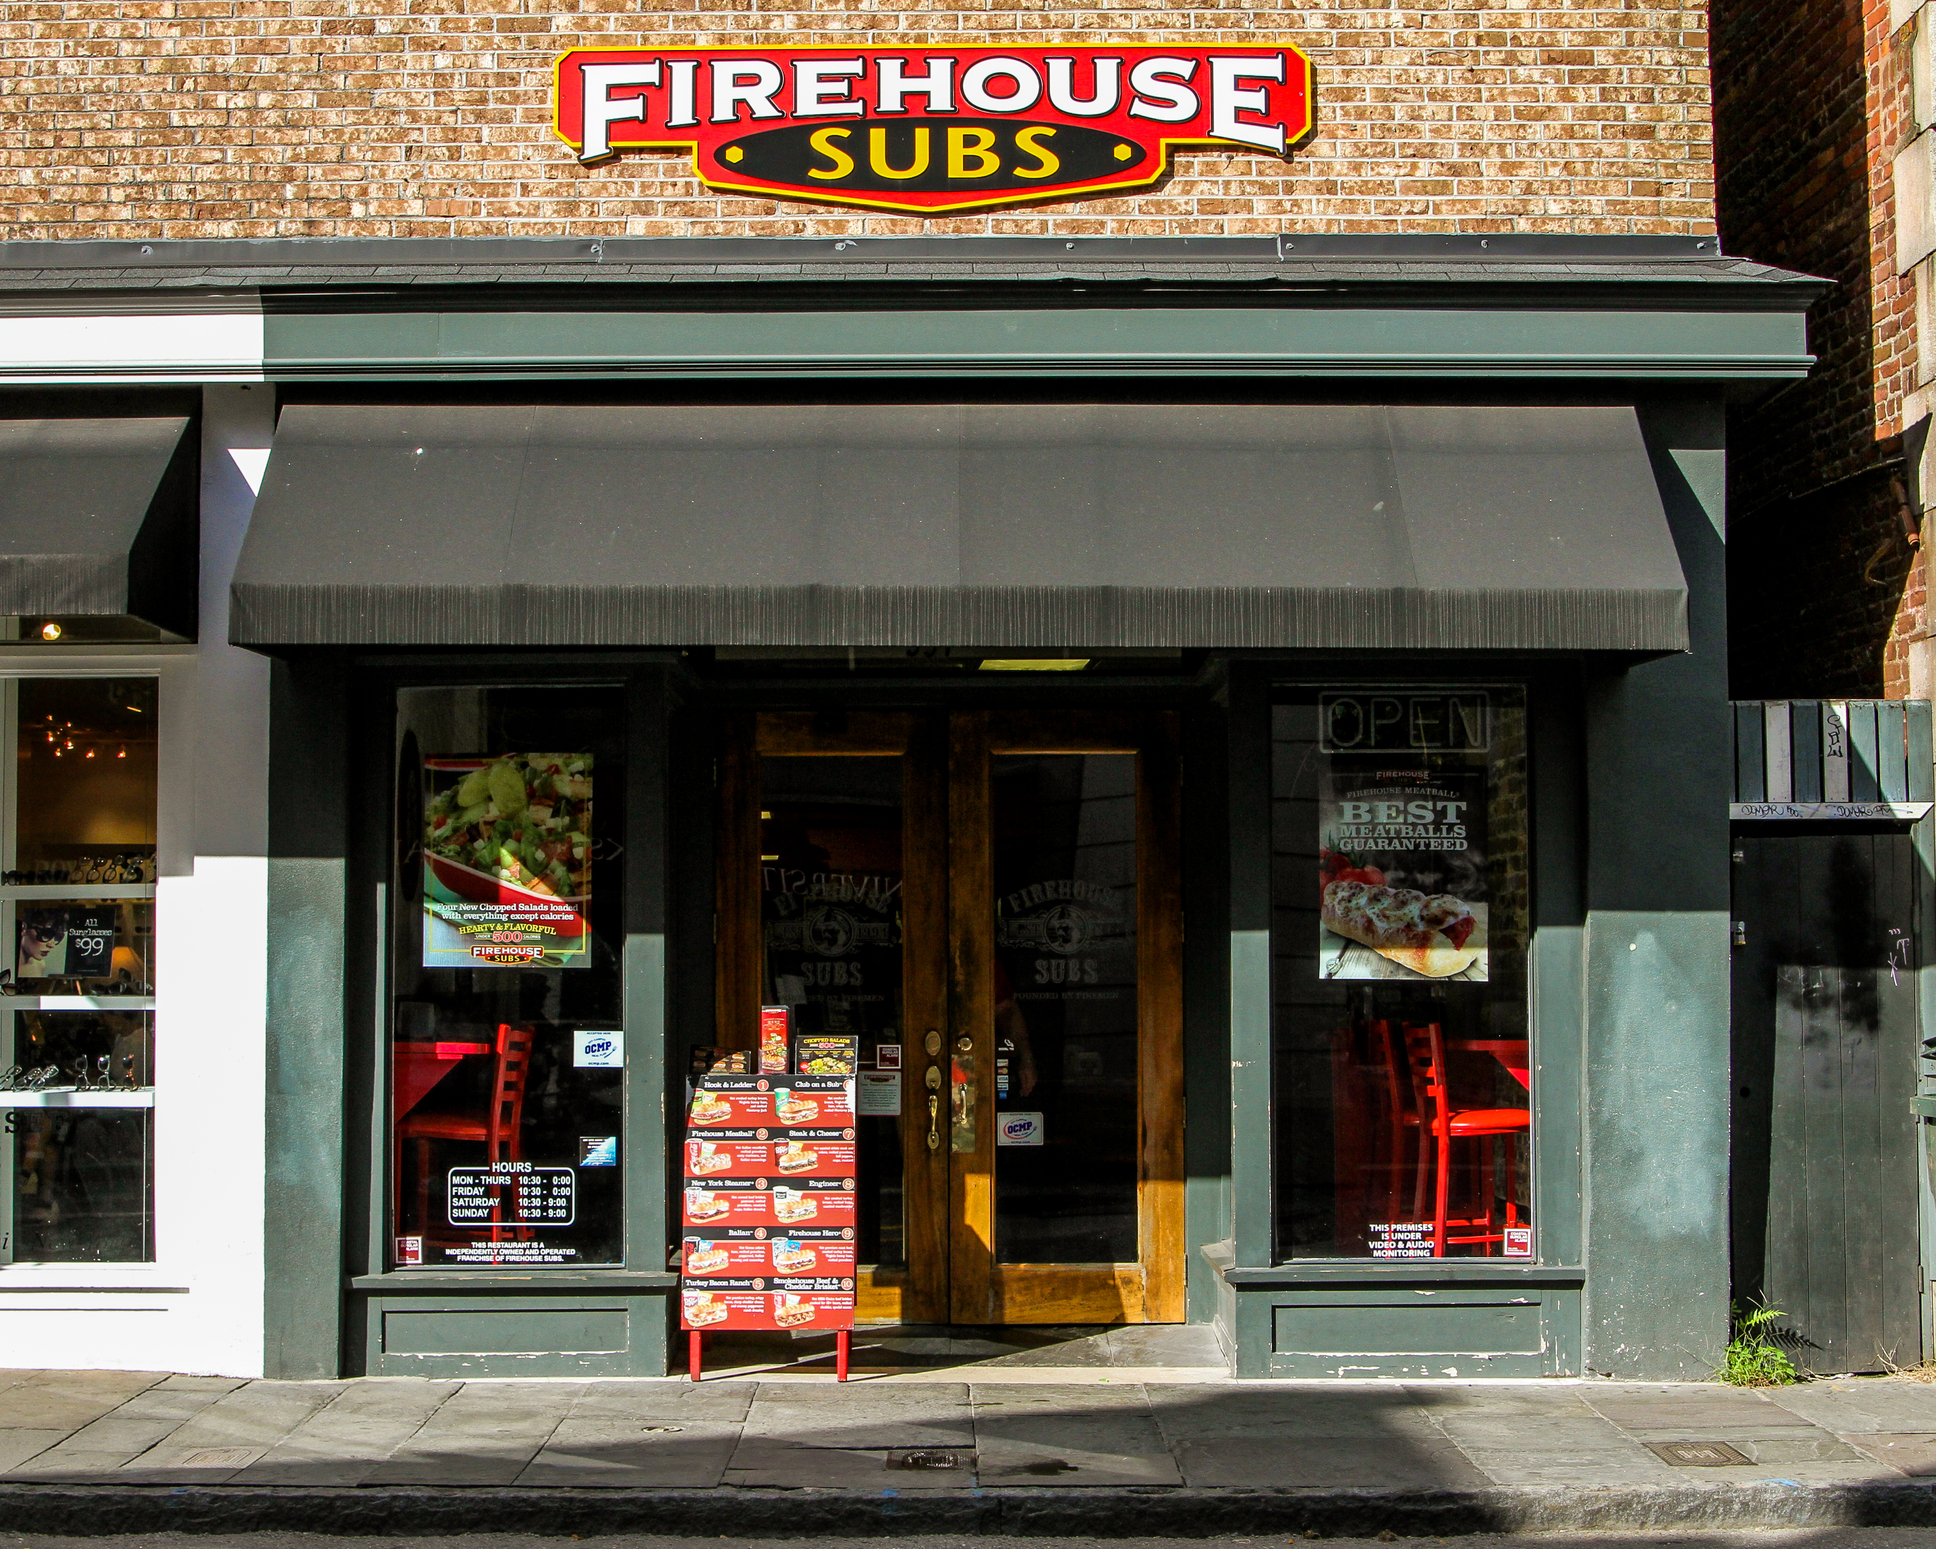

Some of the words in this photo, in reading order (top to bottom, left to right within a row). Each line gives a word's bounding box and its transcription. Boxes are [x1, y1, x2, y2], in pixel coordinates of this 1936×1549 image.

[577, 52, 1288, 162] FIREHOUSE
[806, 126, 1061, 180] SUBS
[1328, 696, 1481, 747] OPEN
[1376, 770, 1430, 780] FIREHOUSE
[1346, 786, 1402, 799] FIREHOUSE
[1339, 801, 1467, 824] BEST
[1339, 825, 1467, 838] MEATBALLS
[1339, 838, 1468, 851] GUARANTEED
[438, 904, 458, 912] Four
[459, 904, 478, 912] New
[479, 904, 517, 913] Chopped
[518, 903, 549, 912] Salads
[550, 903, 579, 912] loaded
[84, 918, 98, 926] All
[442, 912, 462, 921] with
[463, 912, 508, 922] everything
[510, 912, 539, 922] except
[540, 913, 575, 922] calories
[69, 928, 112, 937] Sunglasses
[458, 923, 496, 936] HEARTY
[504, 923, 557, 936] FLAVORFUL
[492, 932, 523, 943] 500
[75, 938, 104, 956] $99
[472, 946, 542, 959] FIREHOUSE
[800, 961, 864, 986] SUBS
[1034, 959, 1099, 984] SUBS
[584, 1041, 612, 1054] OCMP
[1007, 1121, 1032, 1134] OCMP
[492, 1162, 532, 1173] HOURS
[452, 1176, 474, 1185] MON
[480, 1176, 512, 1185] THURS
[518, 1176, 542, 1185] 10:30
[552, 1176, 571, 1185] 0:00
[452, 1187, 484, 1196] FRIDAY
[552, 1187, 571, 1196] 0:00
[452, 1198, 500, 1207] SATURDAY
[518, 1198, 542, 1207] 10:30
[548, 1198, 566, 1207] 9:00
[452, 1209, 489, 1218] SUNDAY
[518, 1209, 542, 1218] 10:30
[548, 1209, 566, 1218] 9:00
[1369, 1224, 1390, 1232] THIS
[1390, 1224, 1434, 1232] PREMISES
[1368, 1241, 1396, 1249] VIDEO
[1397, 1241, 1404, 1249] &
[685, 1280, 708, 1288] Turkey
